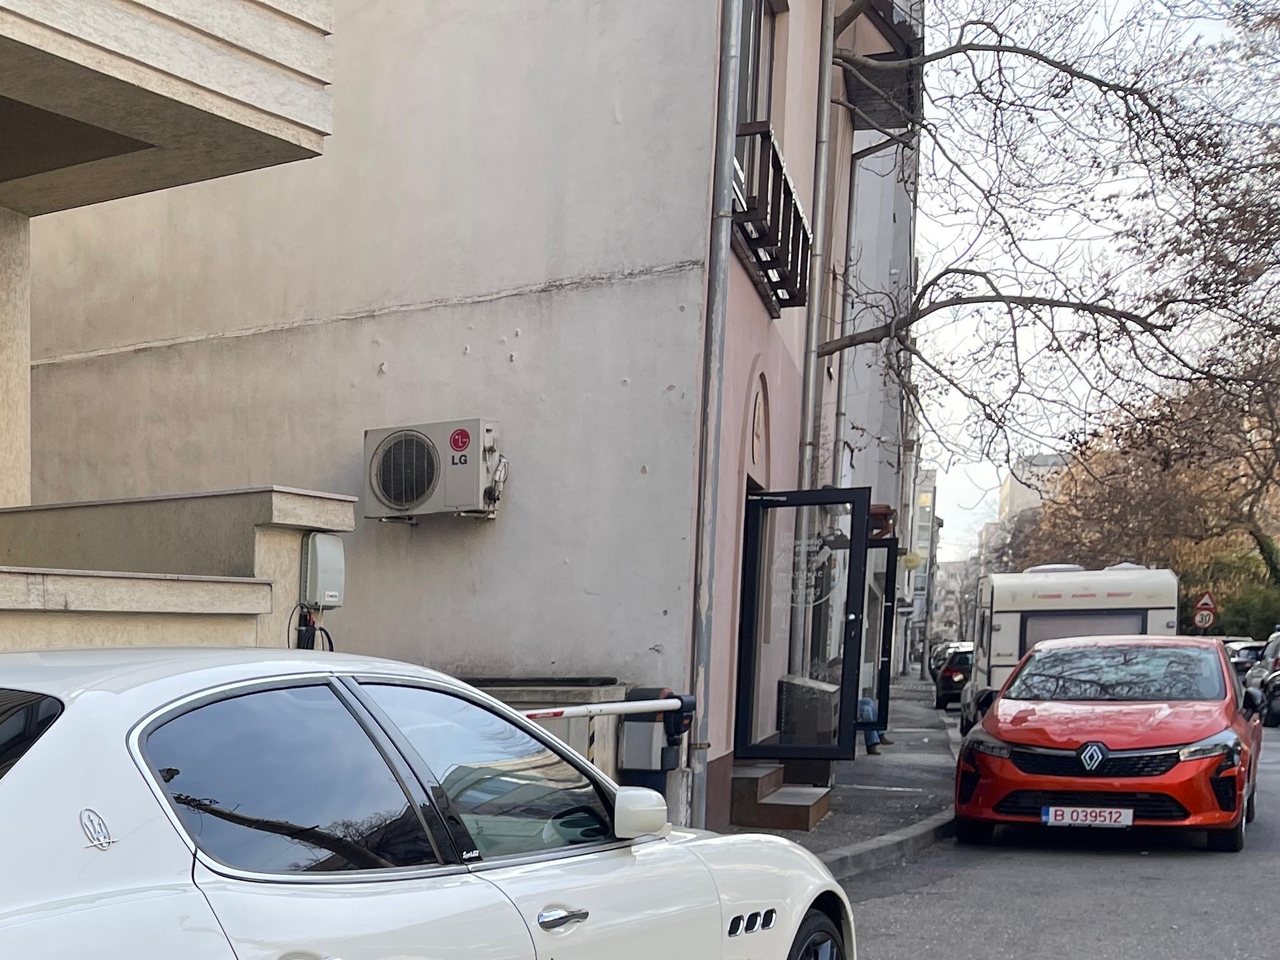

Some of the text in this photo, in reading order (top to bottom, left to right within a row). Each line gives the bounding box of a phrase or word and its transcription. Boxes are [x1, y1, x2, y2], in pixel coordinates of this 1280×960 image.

[452, 454, 467, 465] LG
[1198, 613, 1211, 624] 30
[1054, 809, 1122, 823] B 039512
